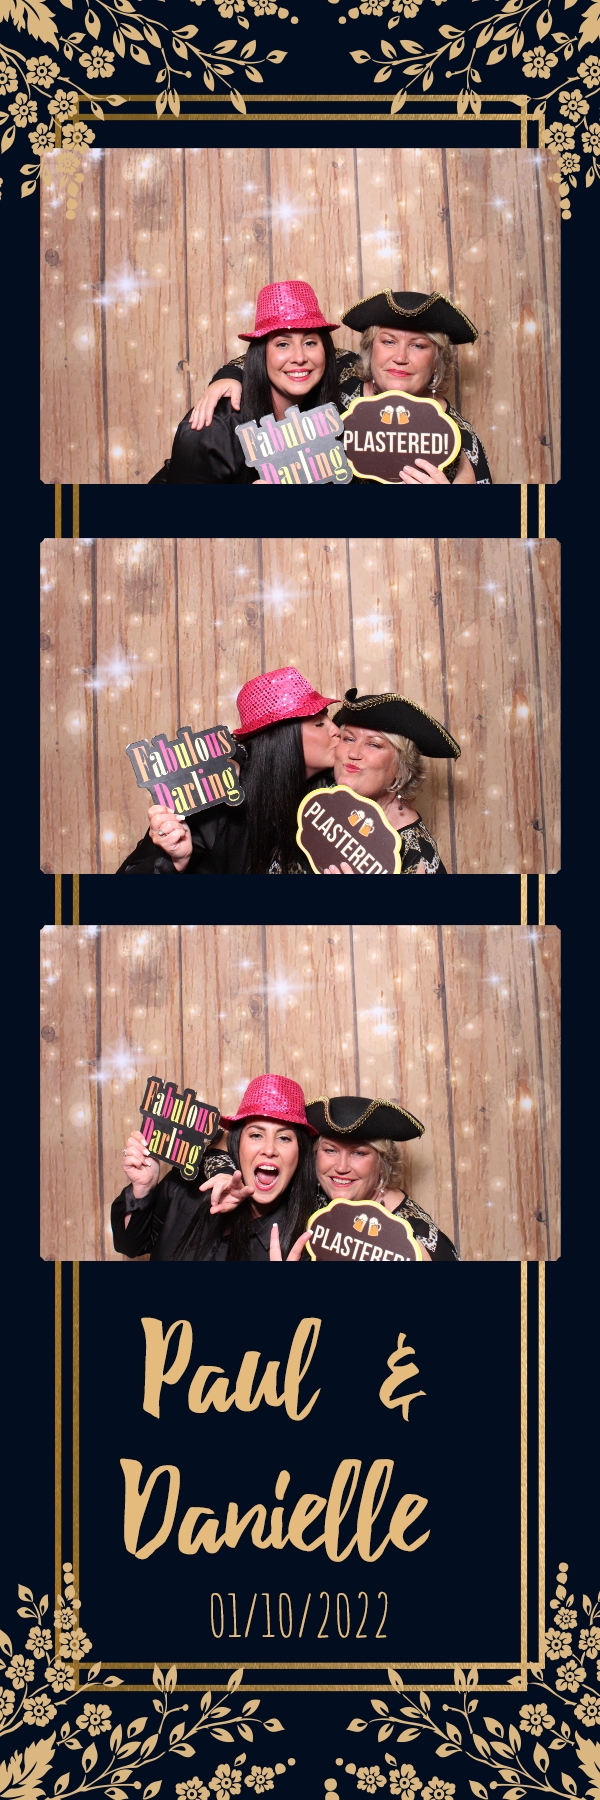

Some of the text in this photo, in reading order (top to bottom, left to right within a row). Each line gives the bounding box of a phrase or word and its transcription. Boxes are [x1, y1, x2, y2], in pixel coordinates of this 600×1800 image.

[241, 408, 340, 462] Fabulous
[343, 430, 449, 455] PLASTERED!
[260, 446, 348, 484] Darling
[130, 730, 232, 783] Fabulous
[153, 766, 240, 814] Darling
[303, 801, 389, 874] PLASTERED
[143, 1080, 217, 1136] Fabulous
[142, 1117, 202, 1176] Darling
